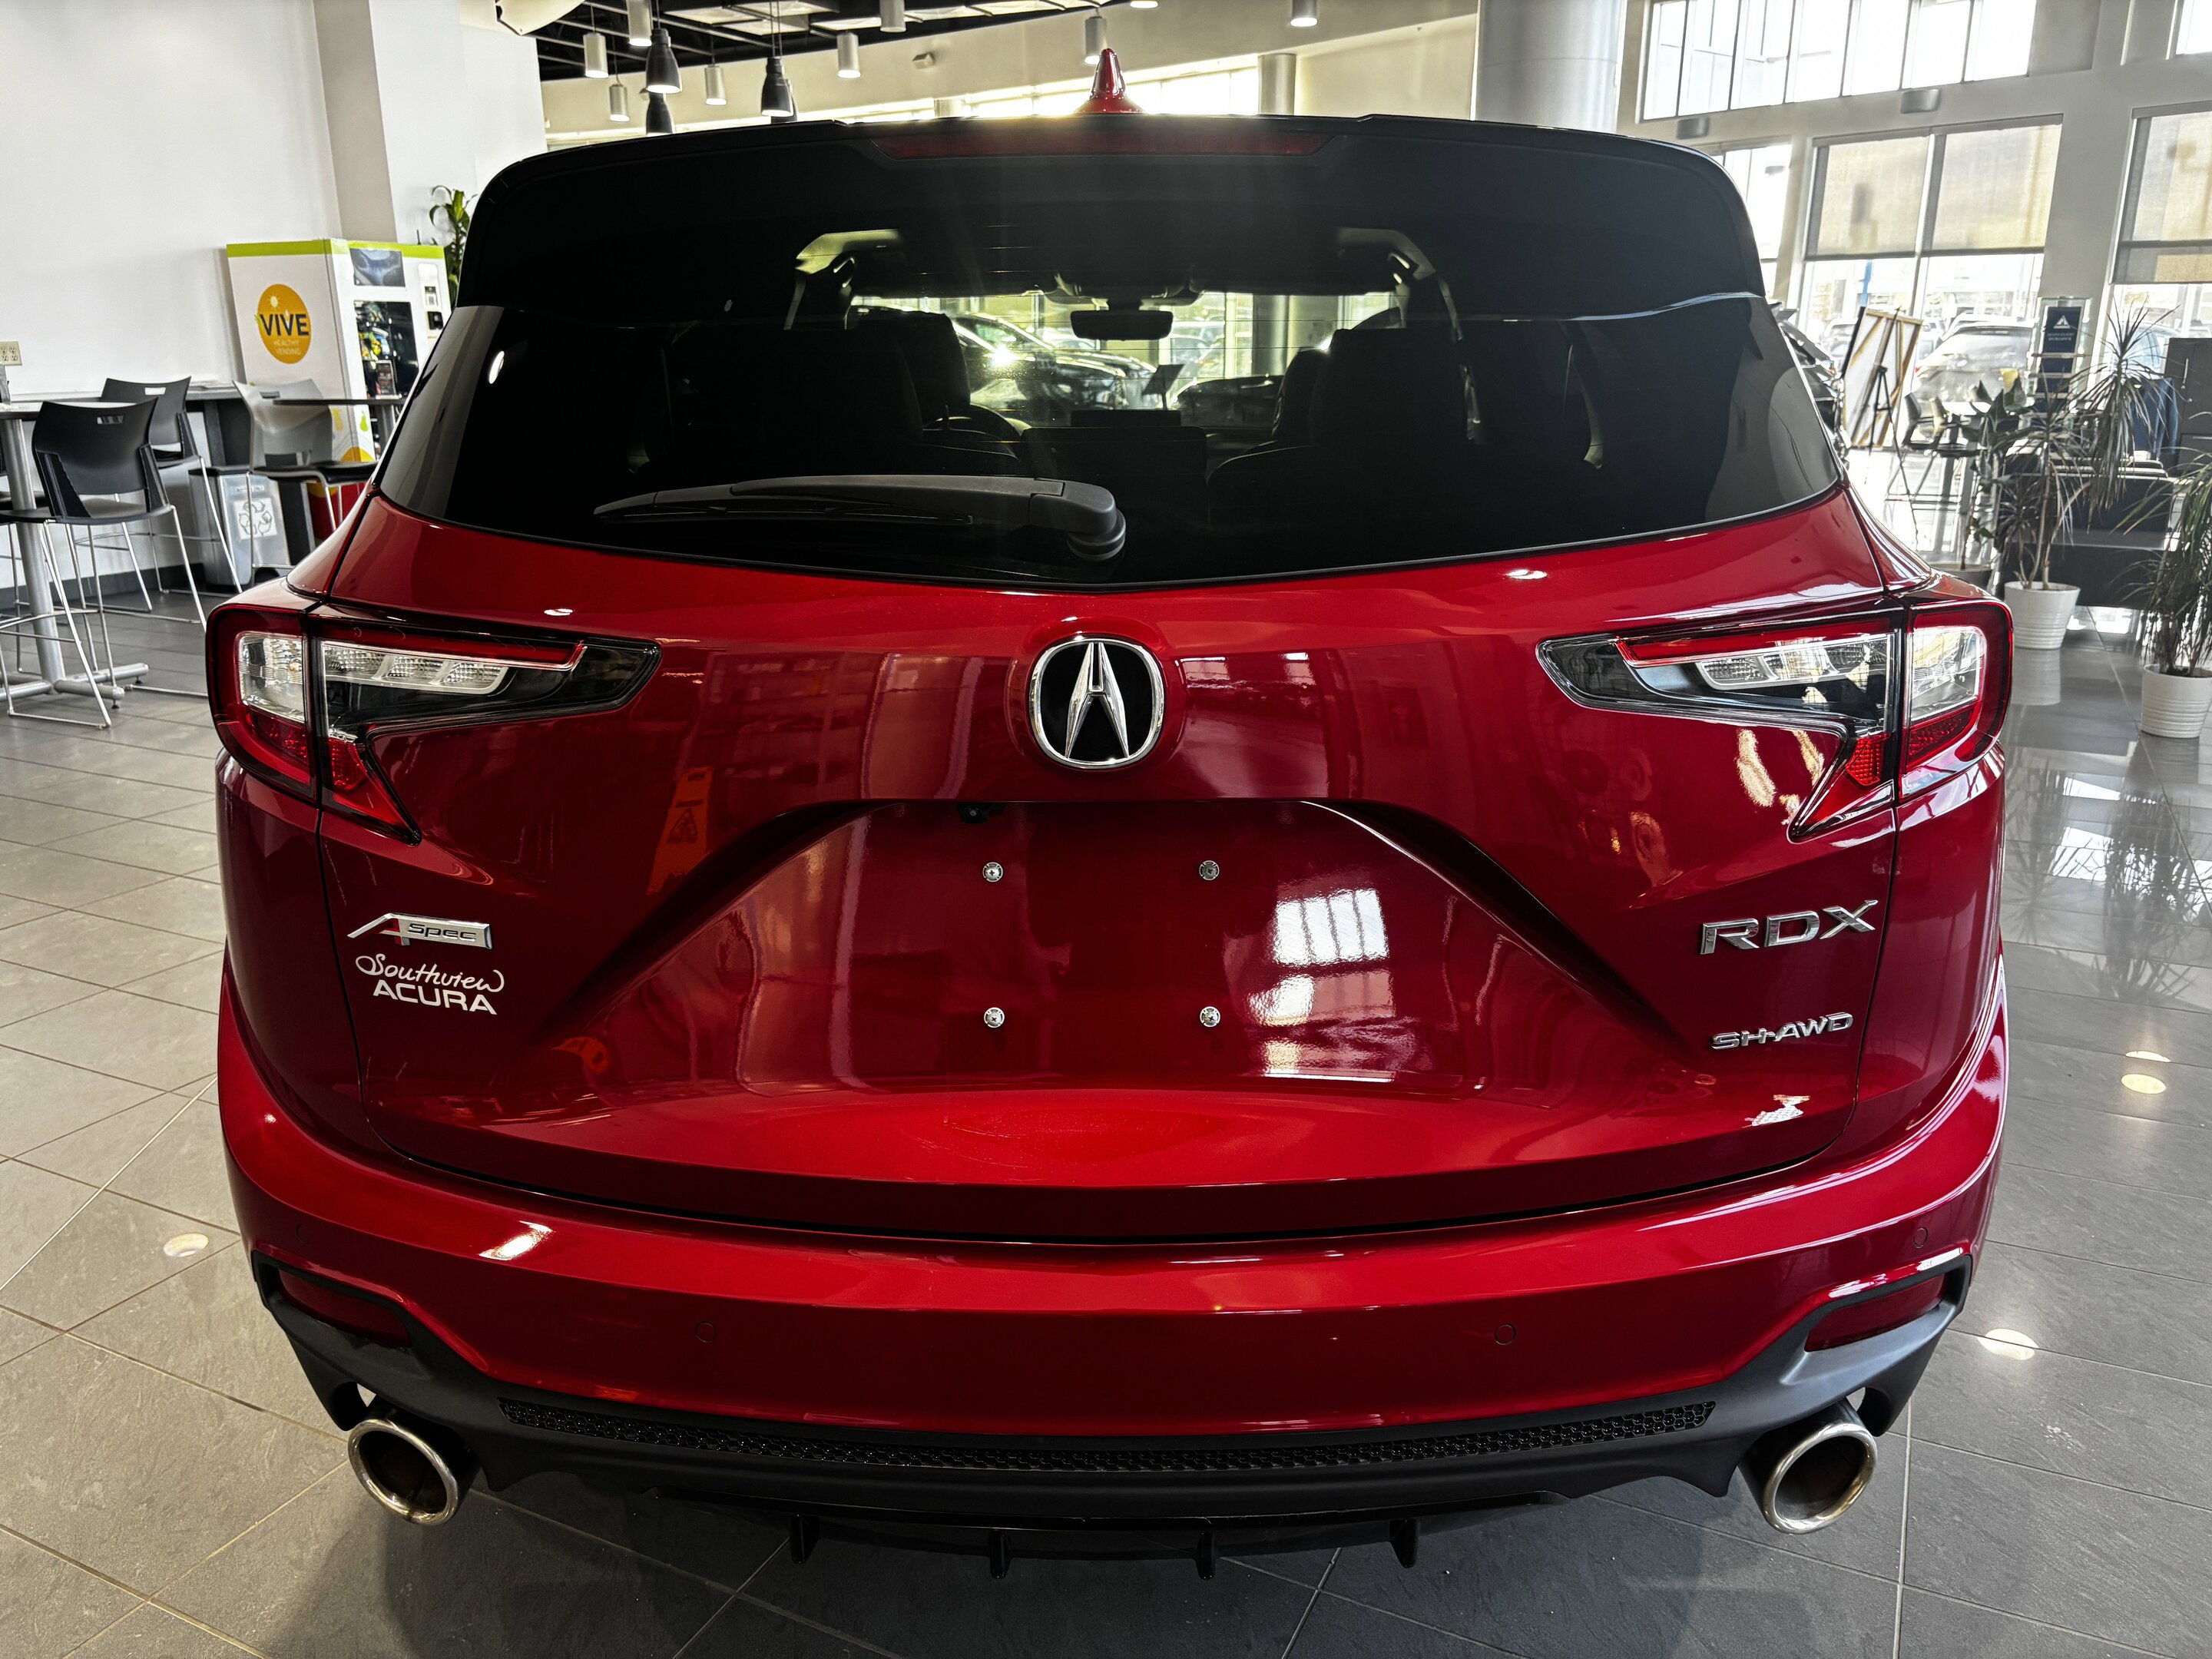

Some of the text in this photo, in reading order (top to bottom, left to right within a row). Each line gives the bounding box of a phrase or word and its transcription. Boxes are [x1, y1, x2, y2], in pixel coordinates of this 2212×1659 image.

[260, 313, 310, 336] VIVE
[1700, 899, 1879, 955] RDX
[355, 953, 505, 993] Southview
[373, 979, 498, 1015] ACURA
[1710, 1012, 1853, 1050] SH-AWD
